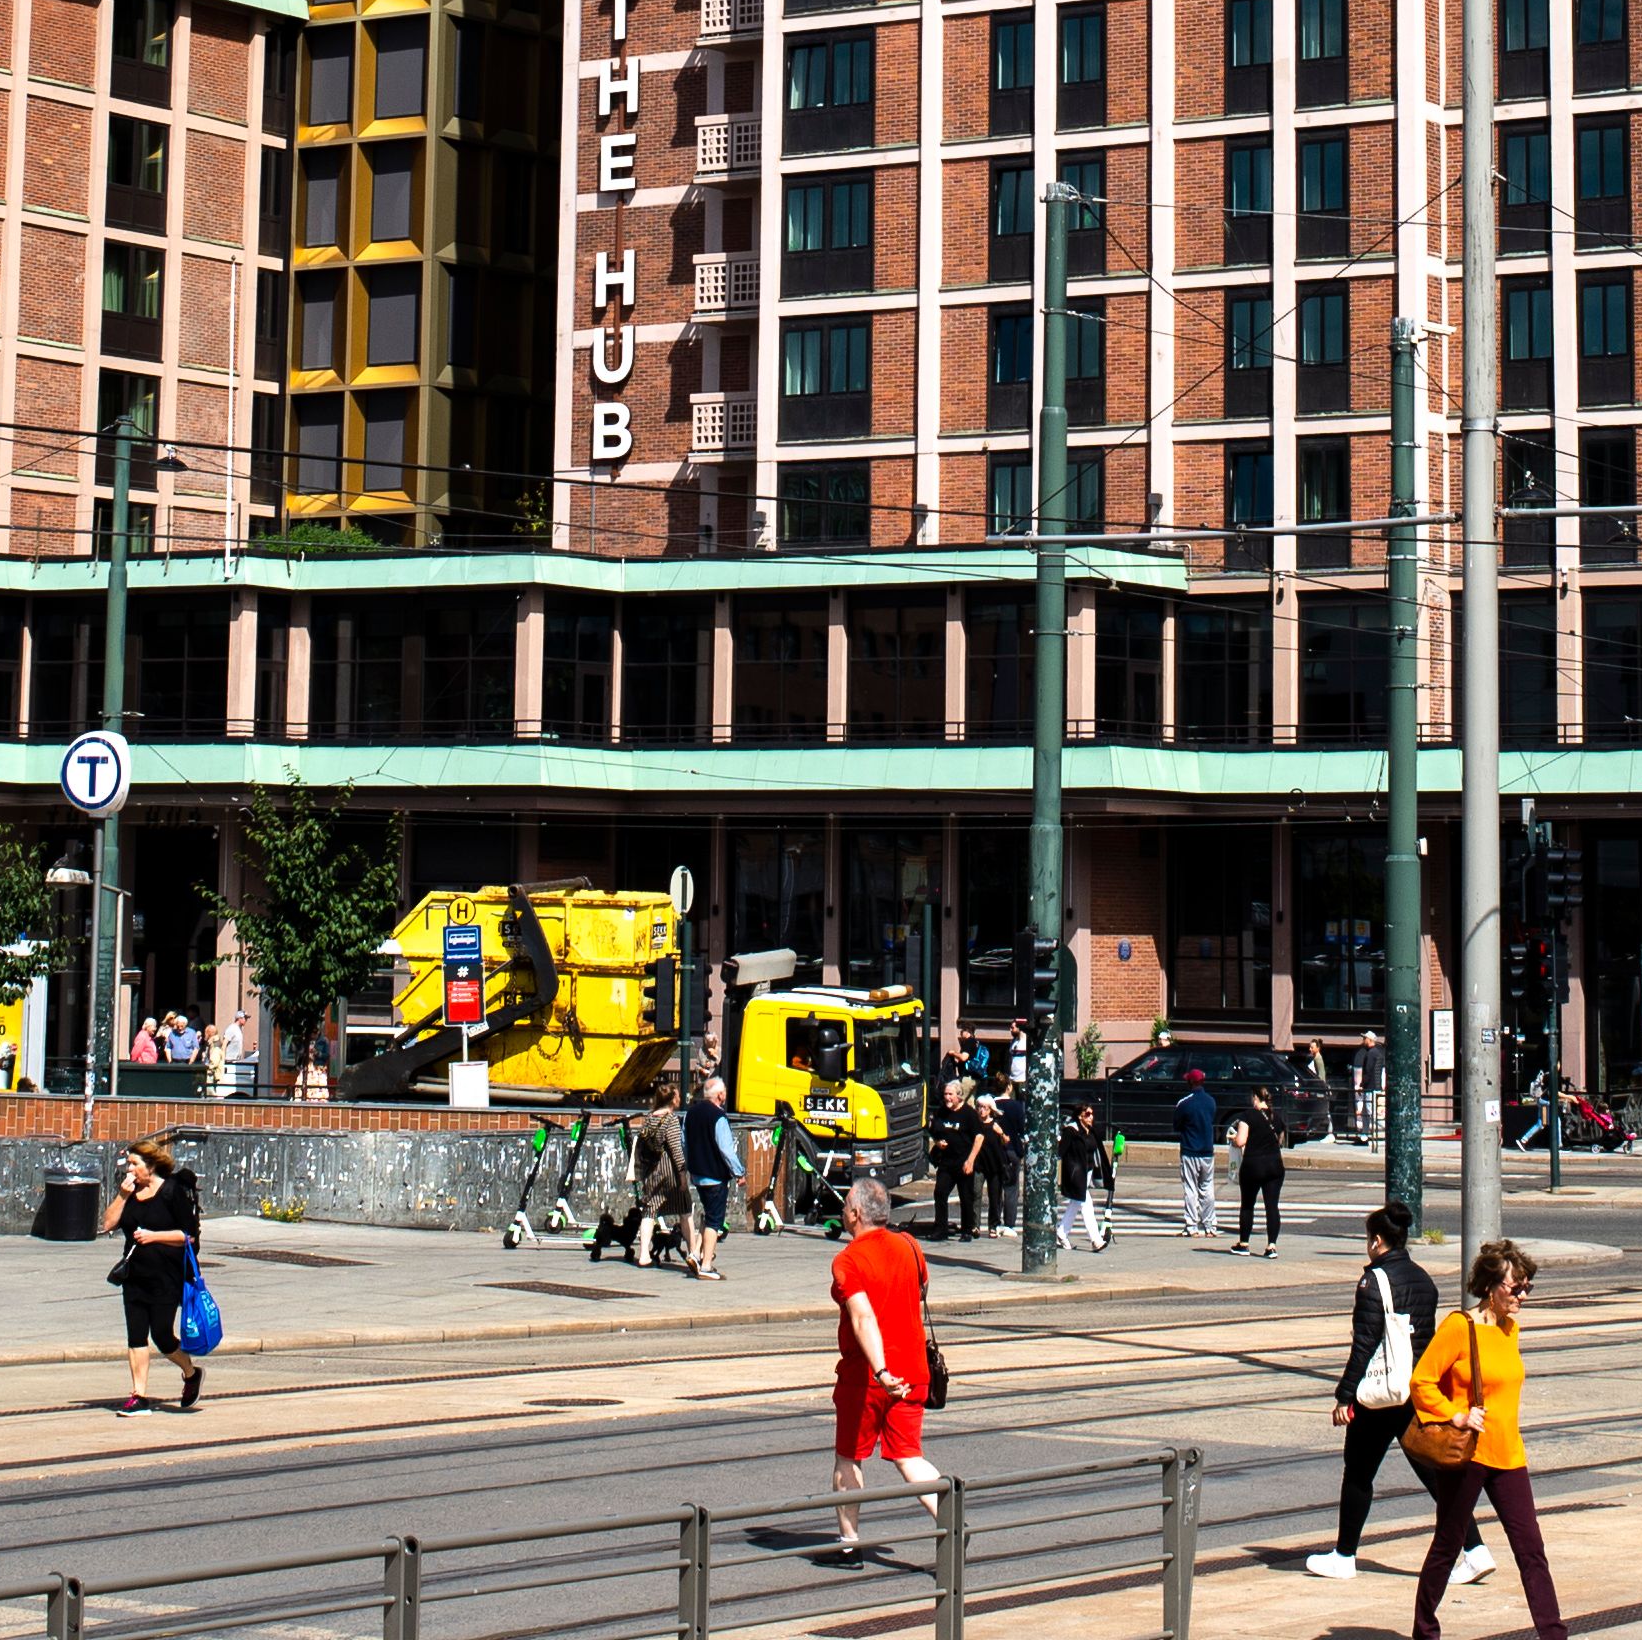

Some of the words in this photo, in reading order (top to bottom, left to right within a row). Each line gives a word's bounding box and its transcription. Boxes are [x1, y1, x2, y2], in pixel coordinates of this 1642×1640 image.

[592, 249, 636, 460] HUB
[77, 756, 109, 797] T
[456, 903, 468, 919] H
[806, 1097, 846, 1111] SEKK
